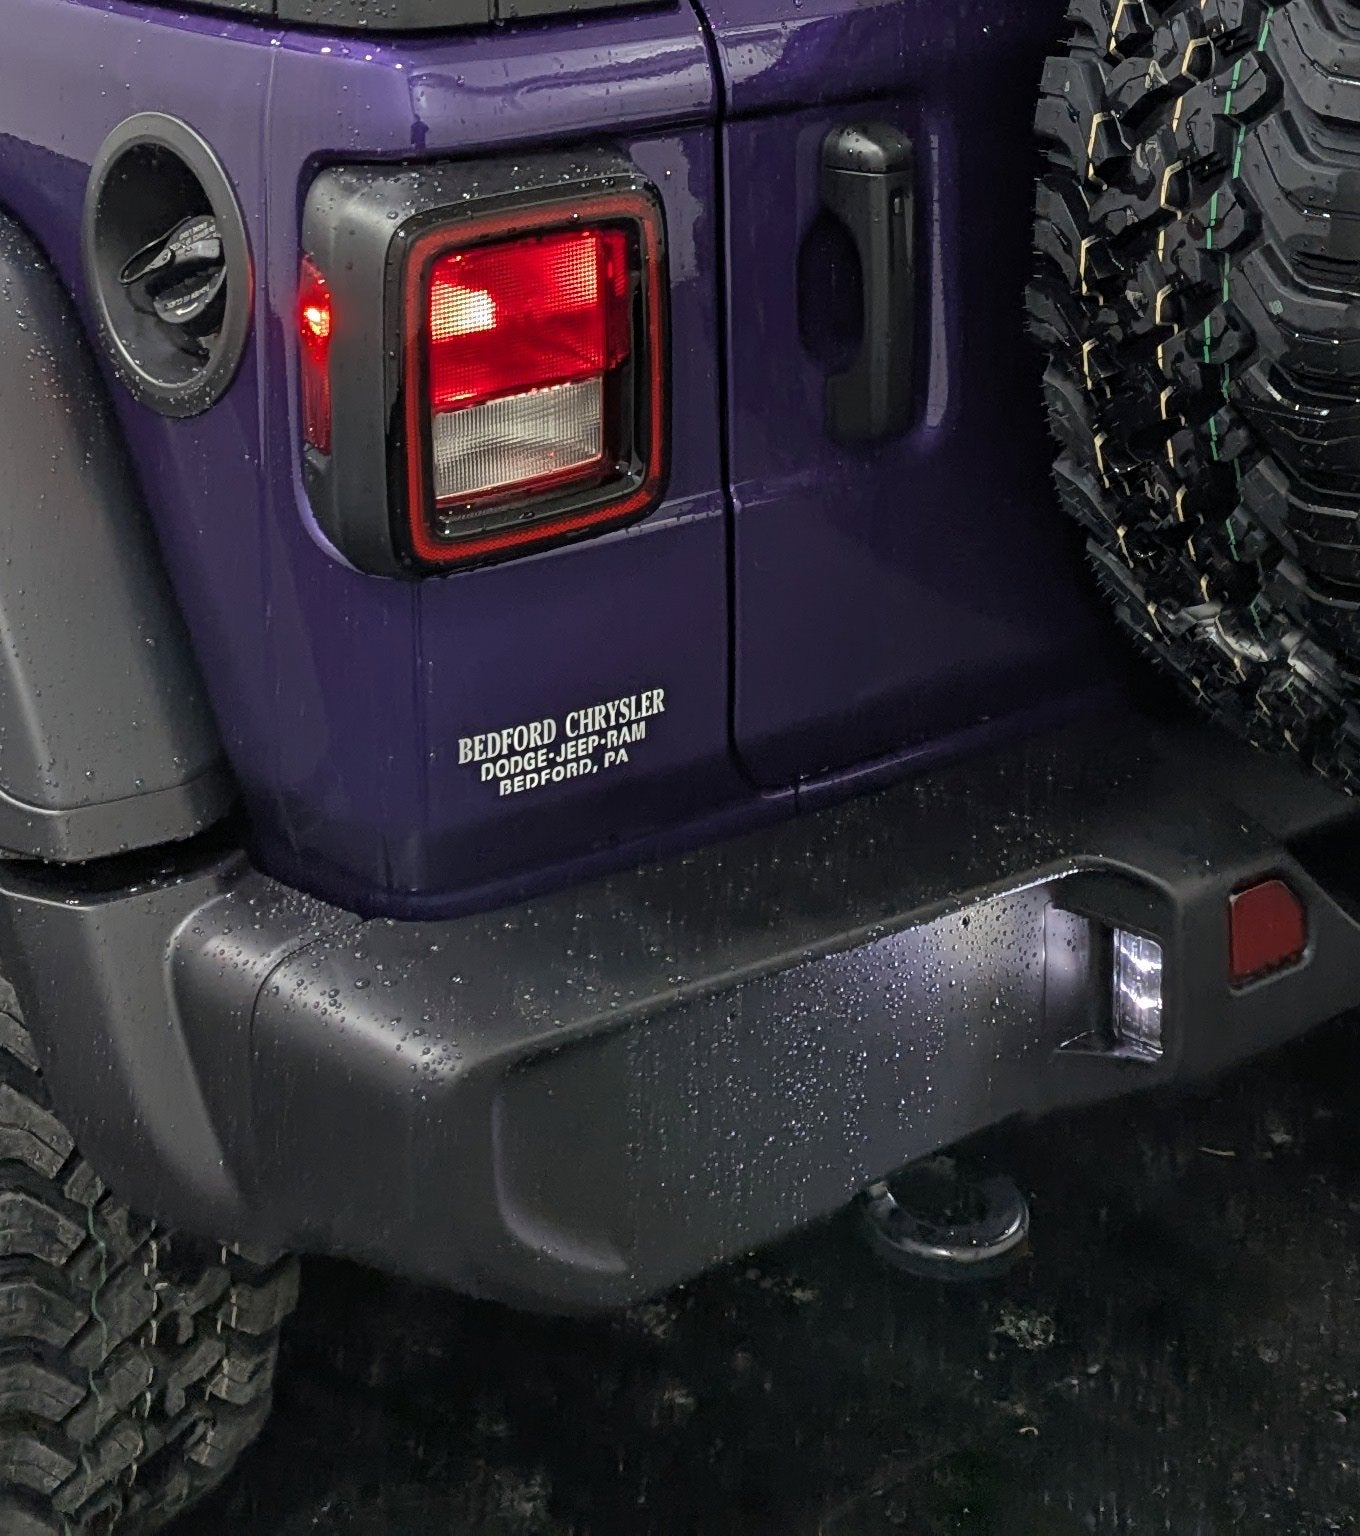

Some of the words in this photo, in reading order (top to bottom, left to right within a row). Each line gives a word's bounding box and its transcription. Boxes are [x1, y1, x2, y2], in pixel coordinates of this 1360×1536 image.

[458, 718, 557, 764] BEDFORD
[565, 688, 665, 738] CHRYSLER
[499, 758, 598, 796] BEDFORD,
[604, 748, 629, 768] PA
